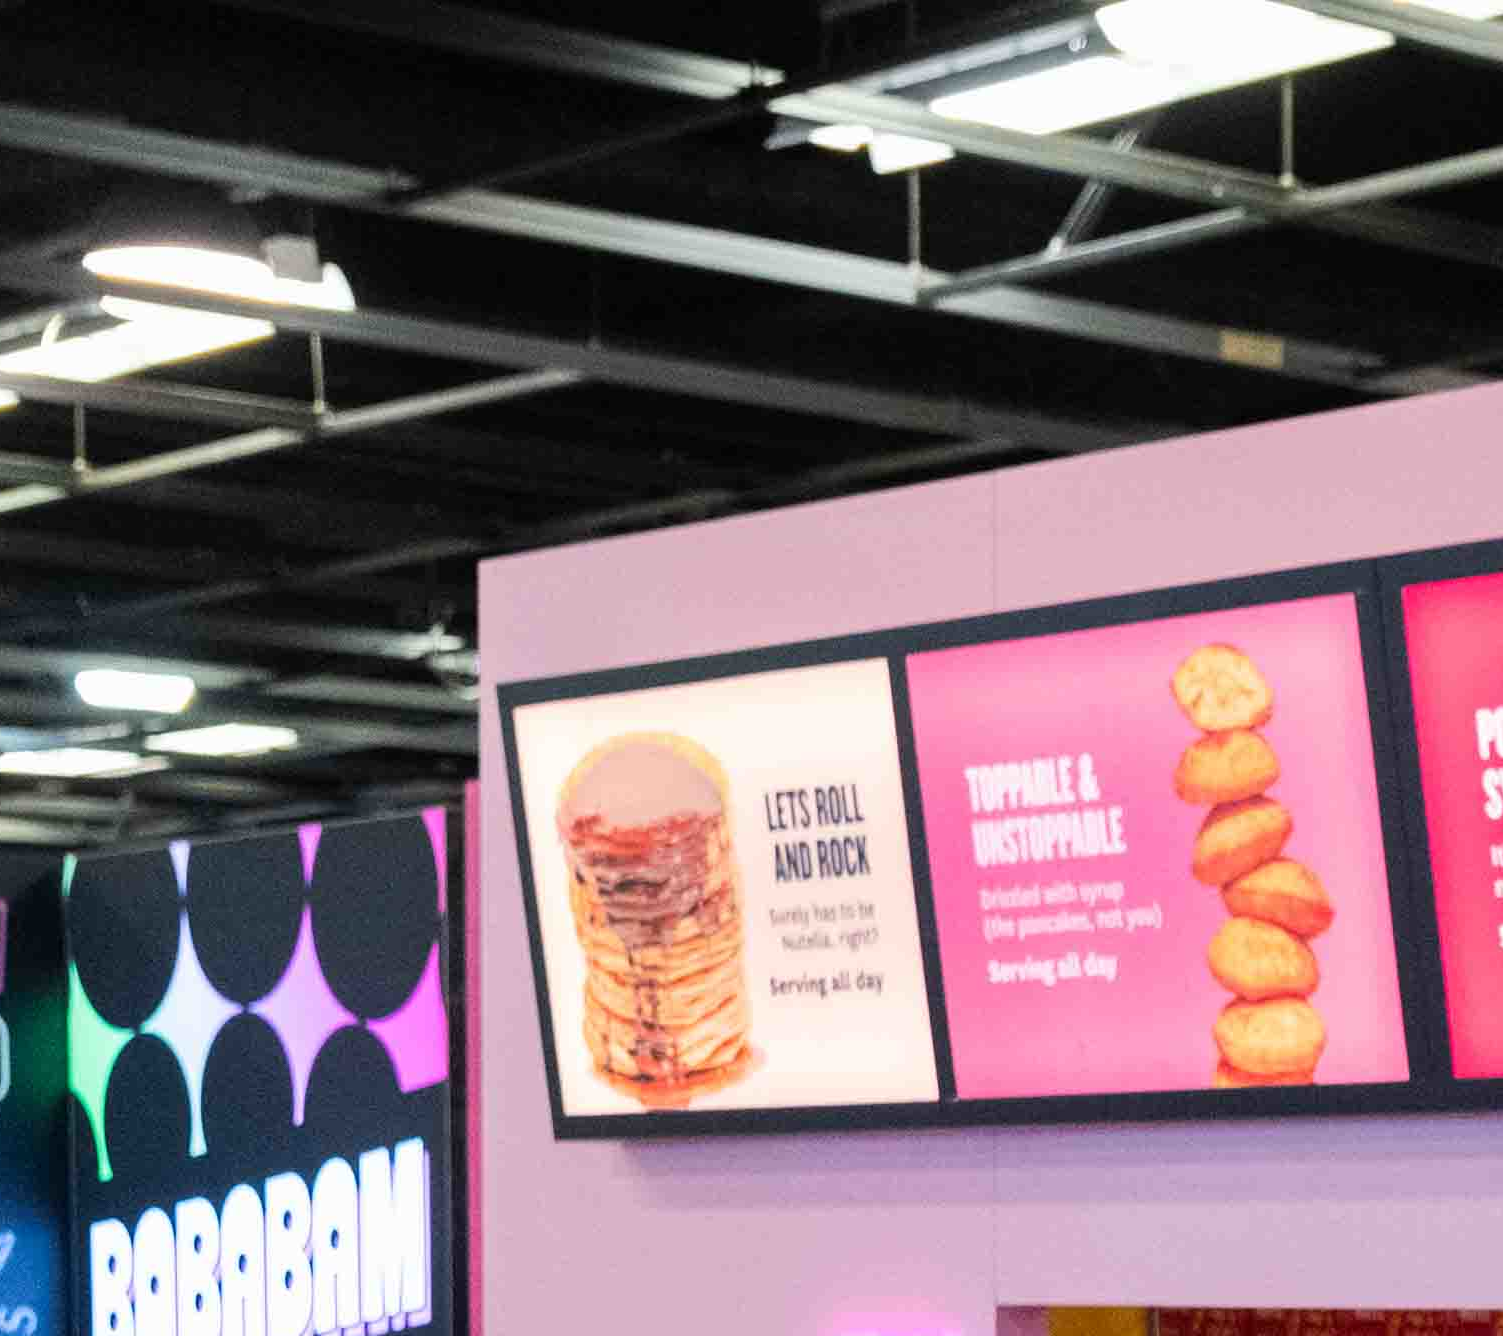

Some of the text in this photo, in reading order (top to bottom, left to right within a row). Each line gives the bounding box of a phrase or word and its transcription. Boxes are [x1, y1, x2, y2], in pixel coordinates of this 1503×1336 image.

[1078, 751, 1101, 802] &
[765, 783, 865, 831] LETS ROLL
[774, 836, 871, 882] AND ROCK
[971, 805, 1128, 868] UNSTOPPABLE
[770, 969, 884, 1000] Serving all day
[987, 951, 1118, 987] Serving all day
